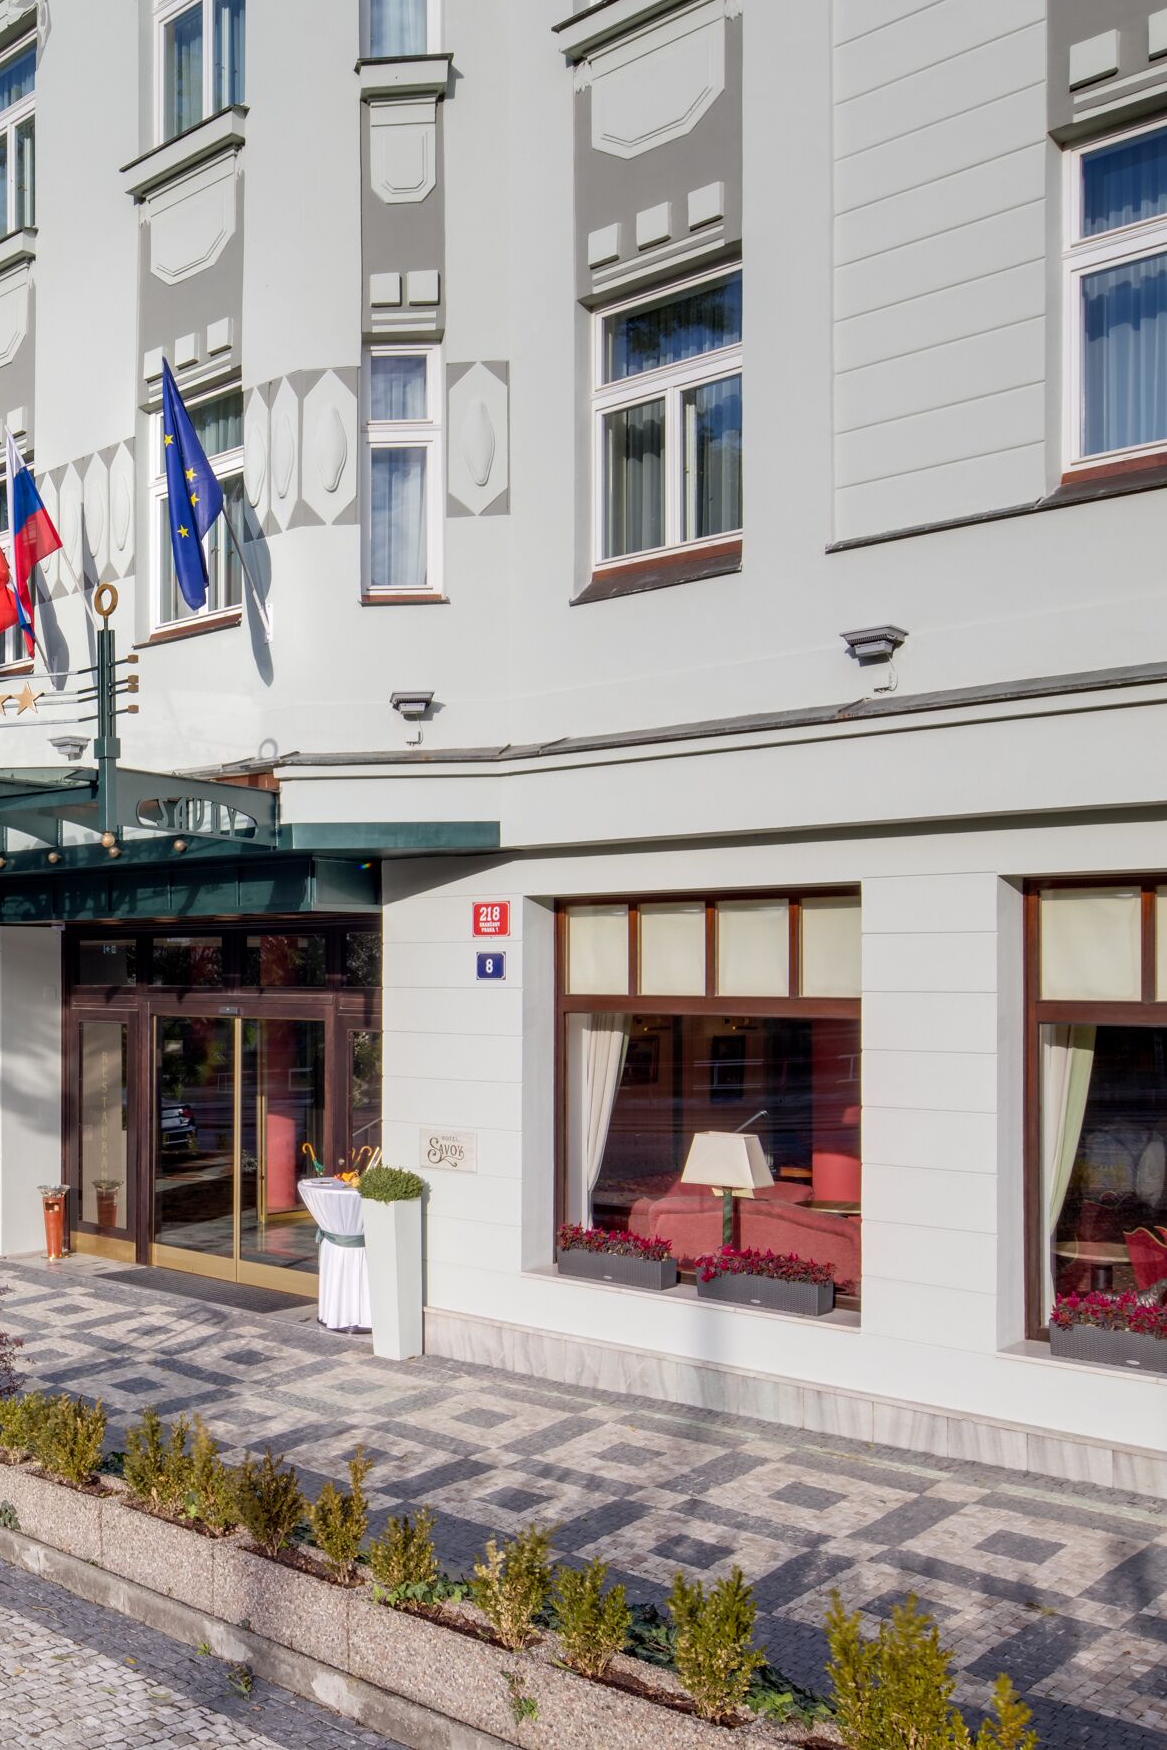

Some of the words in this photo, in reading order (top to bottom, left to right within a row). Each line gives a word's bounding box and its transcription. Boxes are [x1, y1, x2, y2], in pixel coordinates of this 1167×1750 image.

[156, 797, 238, 837] SAVOY
[479, 906, 500, 921] 218
[486, 959, 493, 973] 8
[427, 1137, 465, 1167] SAVOY
